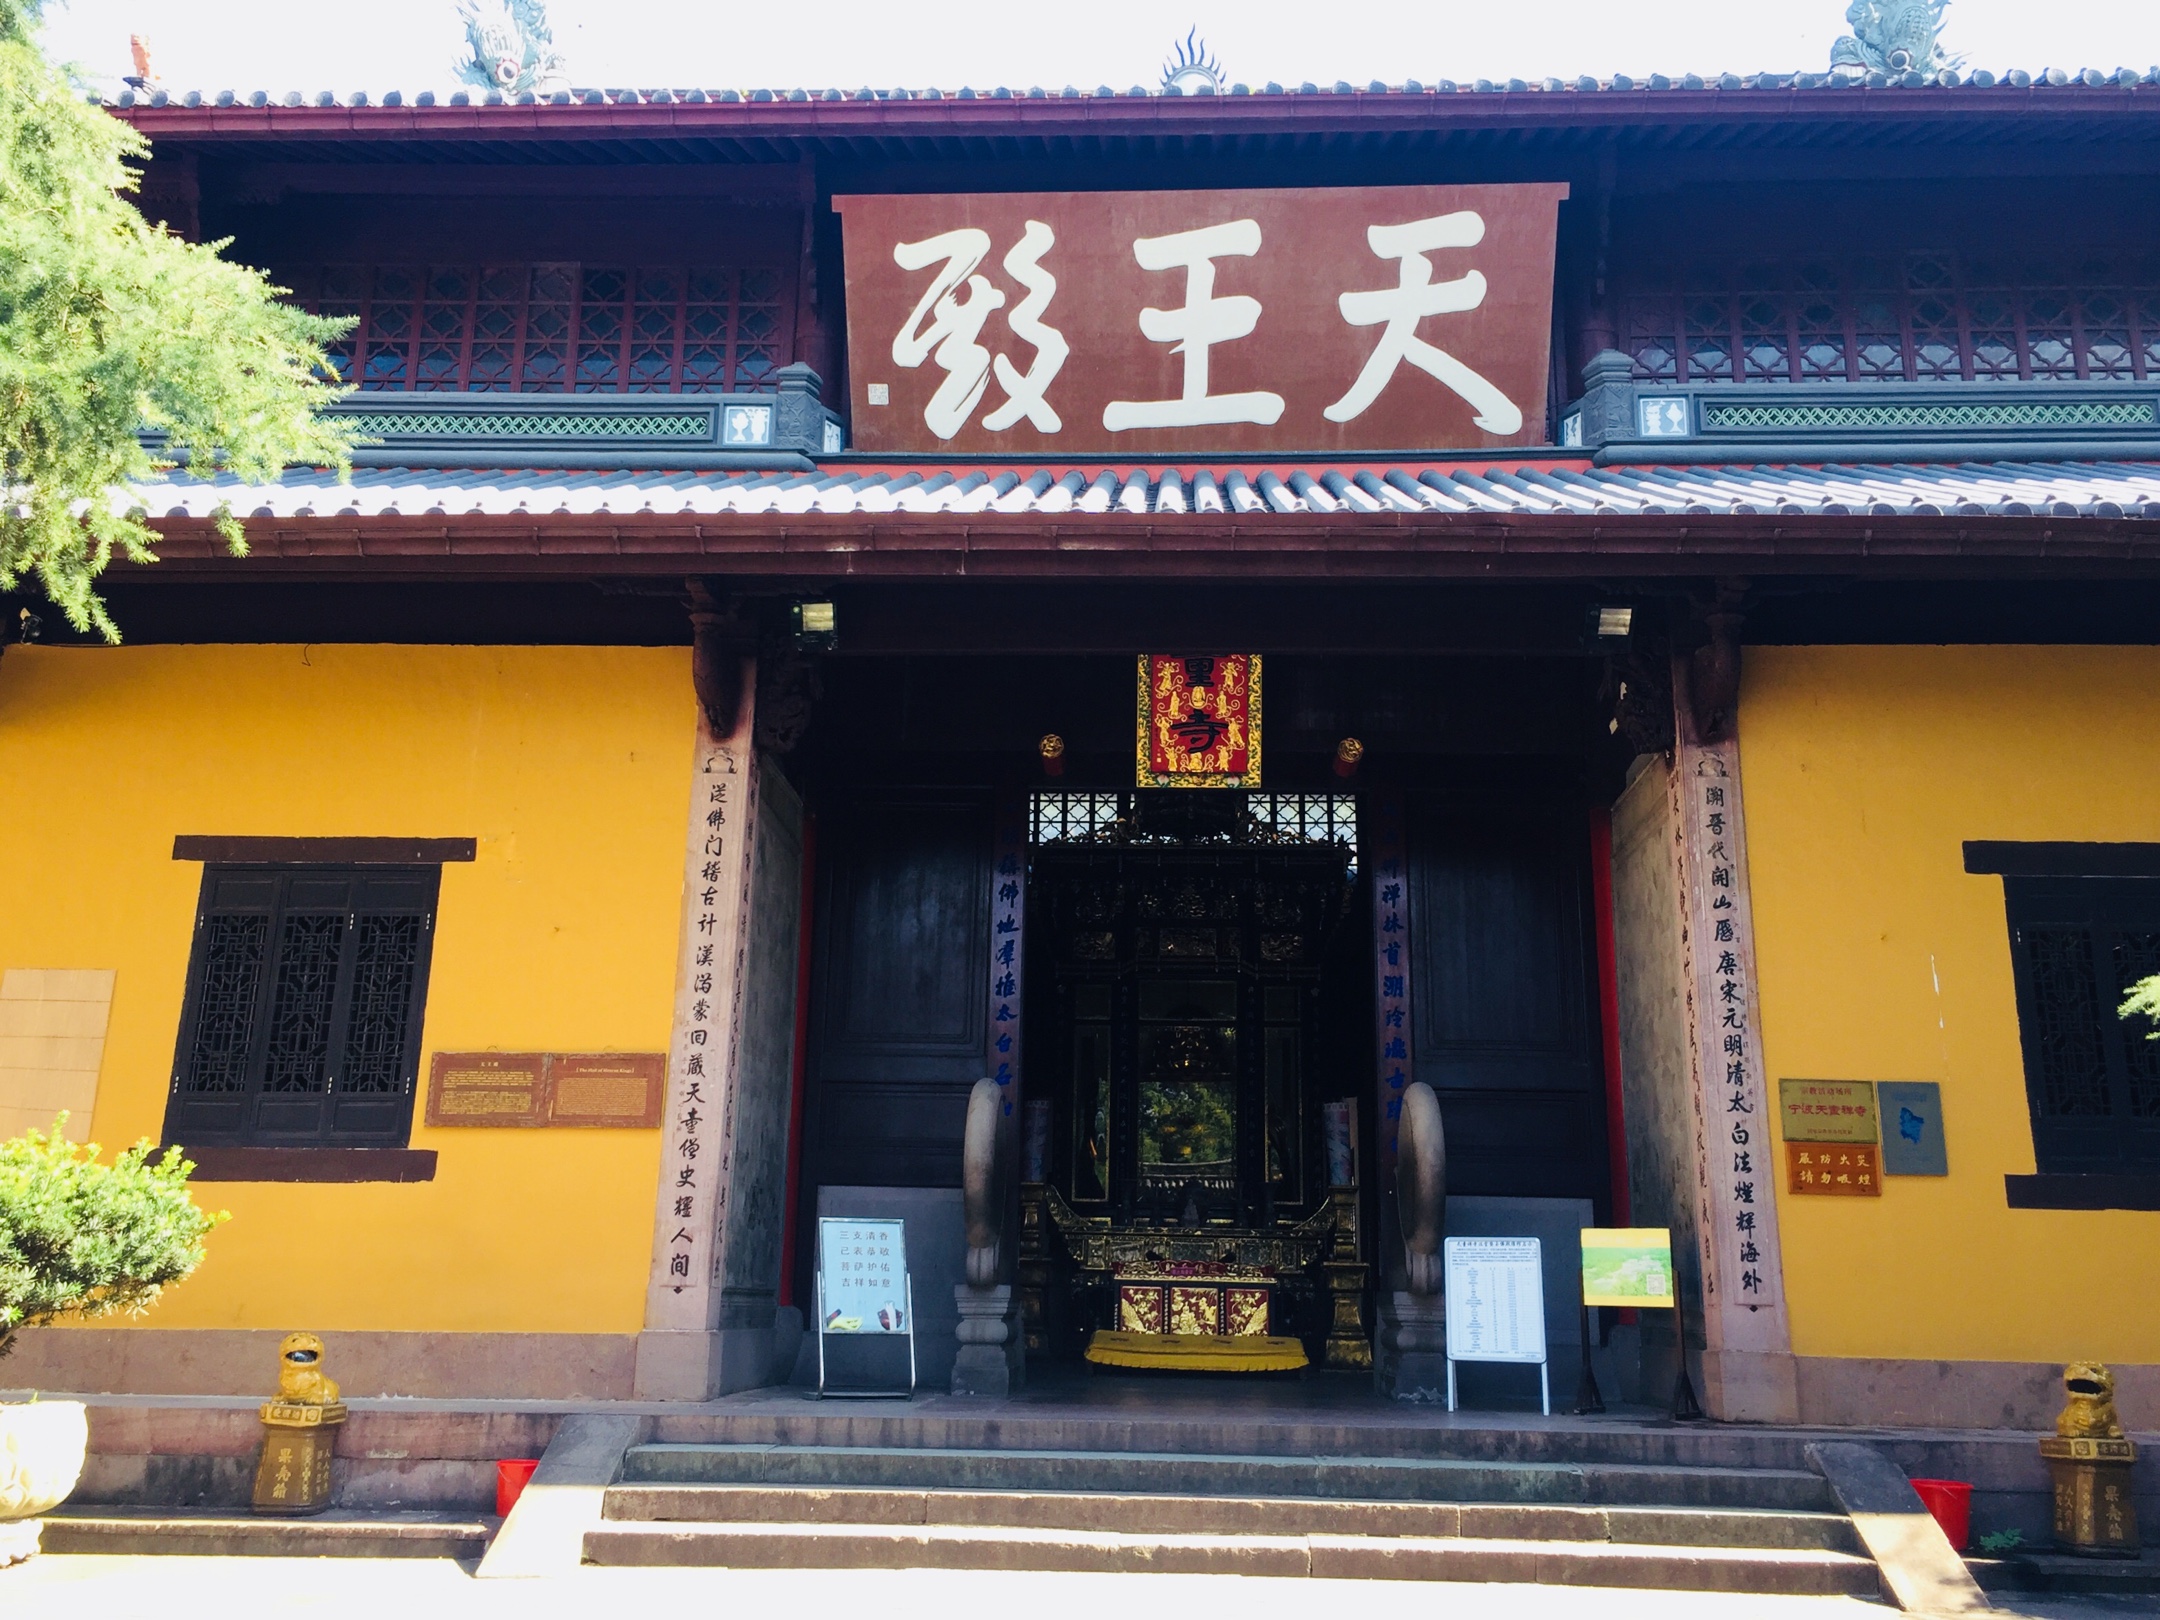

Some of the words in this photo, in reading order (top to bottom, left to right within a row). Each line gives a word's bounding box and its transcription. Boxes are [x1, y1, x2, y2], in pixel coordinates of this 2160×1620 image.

[892, 210, 1523, 439] 天王殿
[840, 1231, 888, 1241] 三支清香
[841, 1262, 890, 1272] 菩萨护佑
[842, 1278, 891, 1288] 吉祥如意
